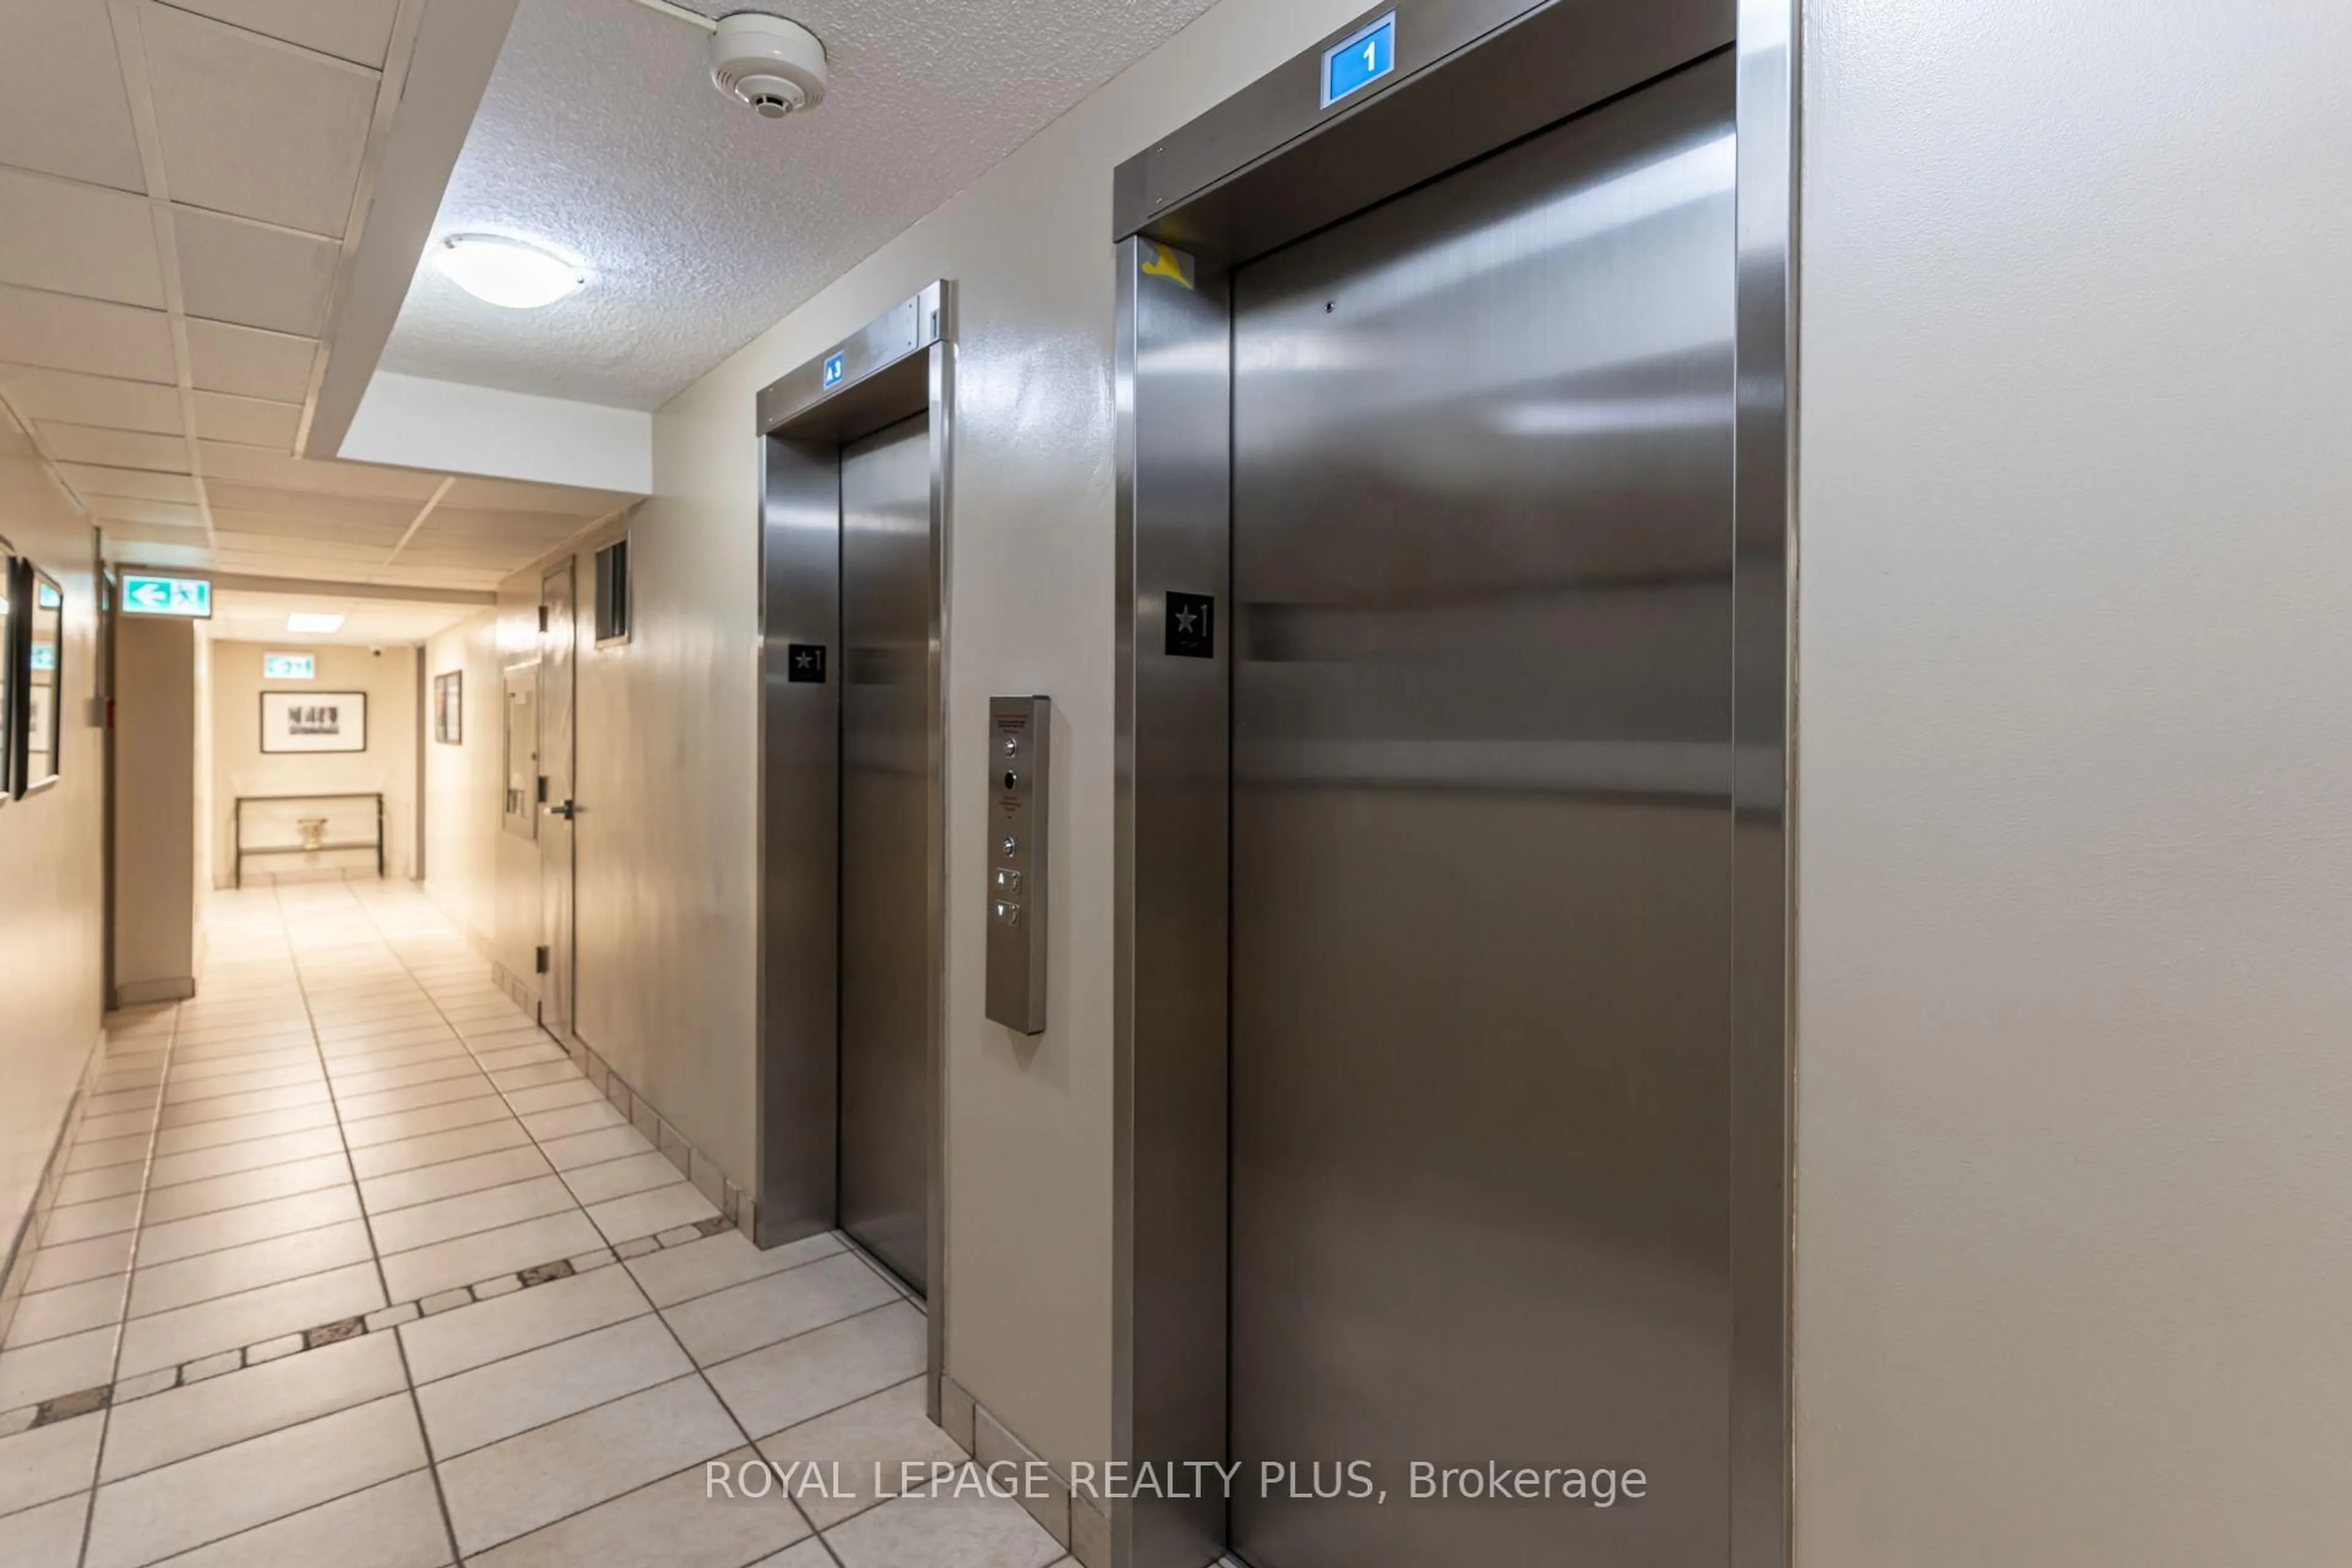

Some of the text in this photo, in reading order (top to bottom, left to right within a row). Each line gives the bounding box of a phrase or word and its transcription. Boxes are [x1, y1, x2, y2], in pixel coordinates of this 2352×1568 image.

[1363, 40, 1376, 72] 1
[1200, 603, 1208, 637] 1
[814, 650, 821, 671] 1
